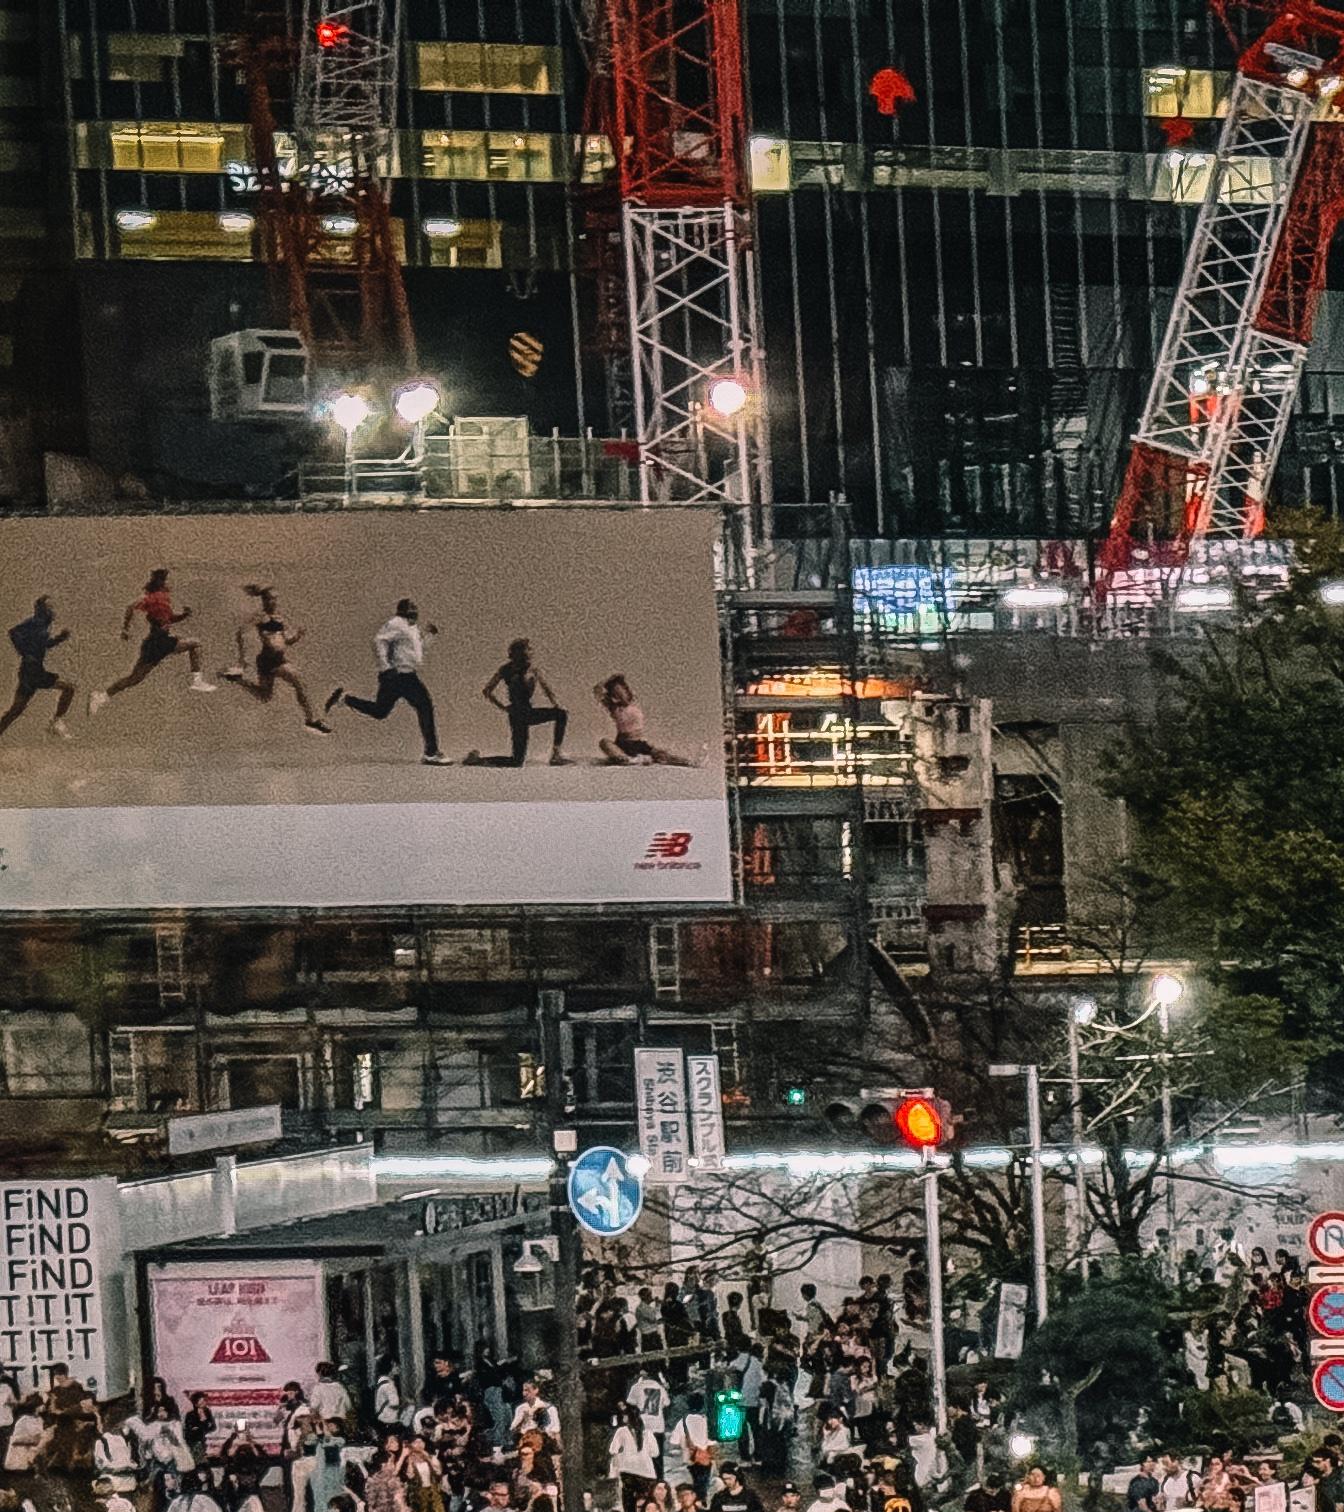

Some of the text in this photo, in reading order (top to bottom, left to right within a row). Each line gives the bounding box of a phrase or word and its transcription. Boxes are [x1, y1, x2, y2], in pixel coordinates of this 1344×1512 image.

[656, 1061, 683, 1173] 渋谷駅前
[224, 1338, 258, 1357] 101
